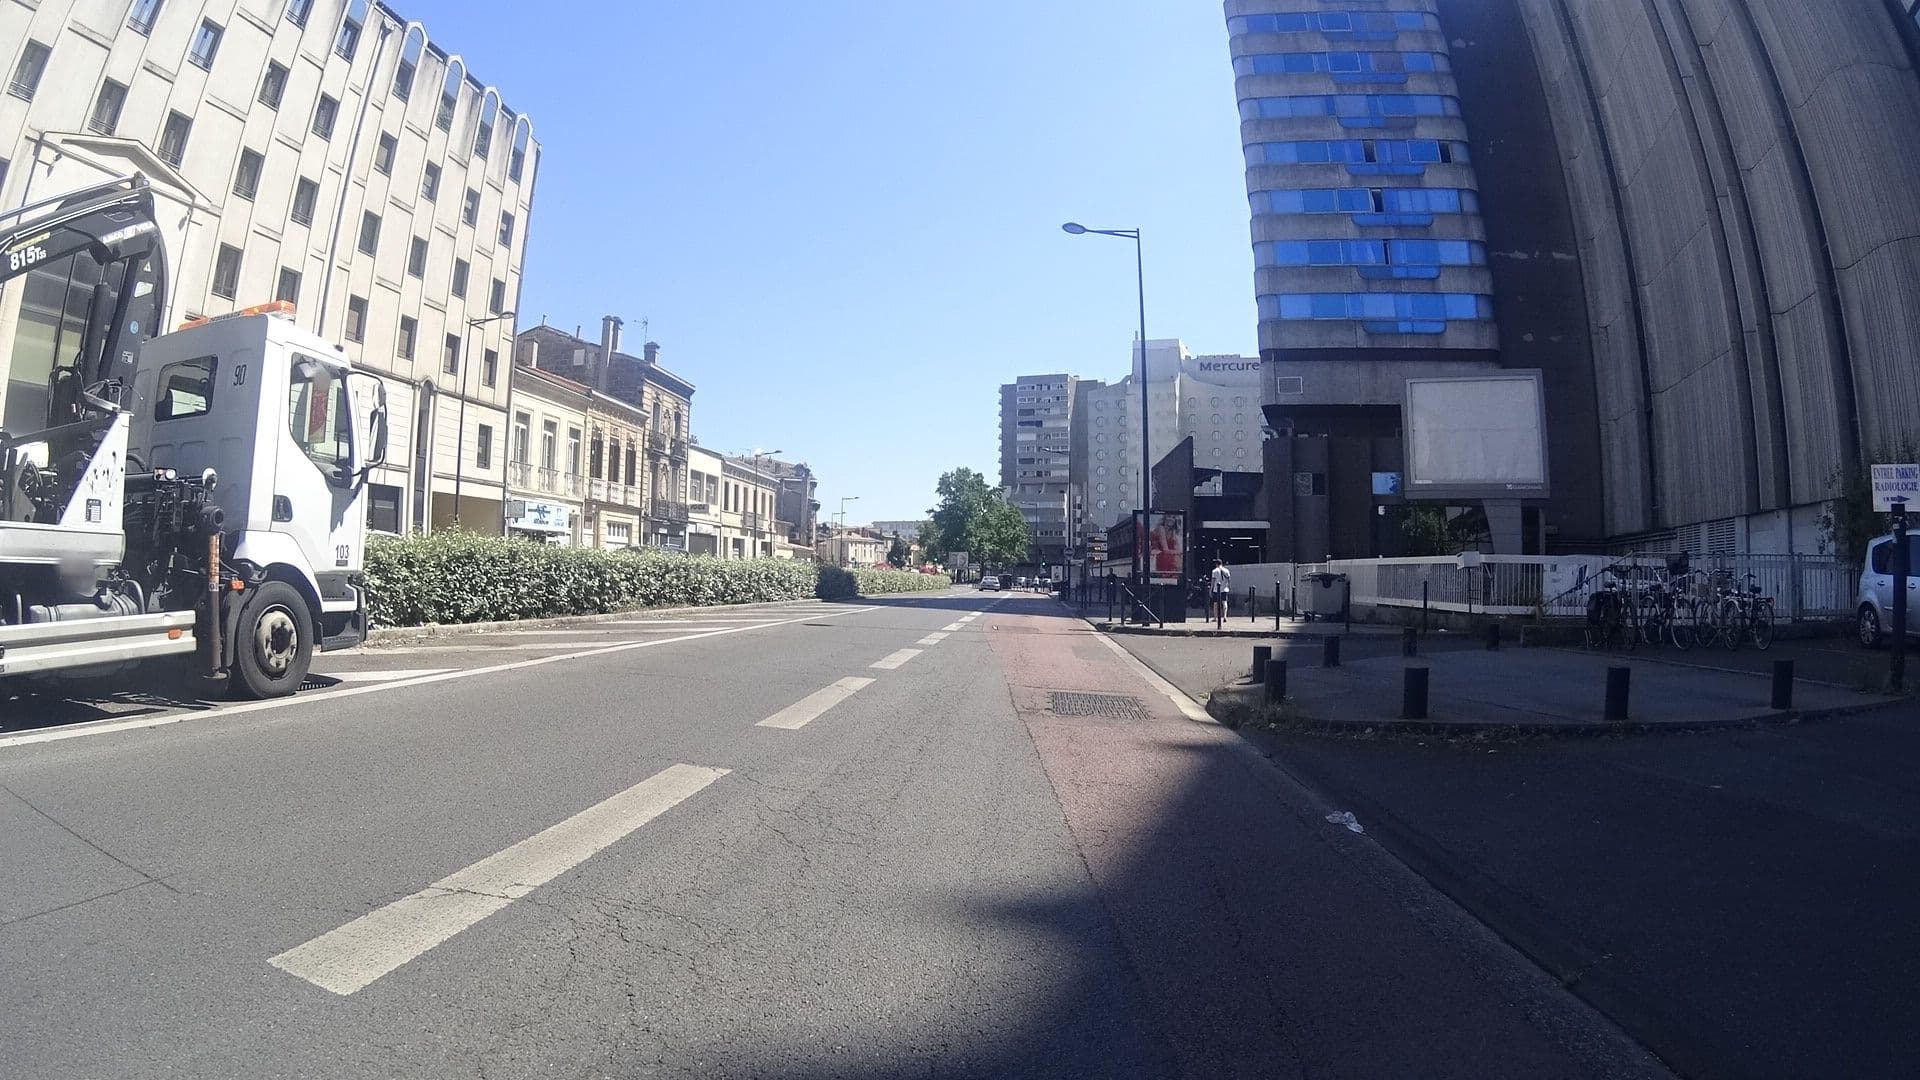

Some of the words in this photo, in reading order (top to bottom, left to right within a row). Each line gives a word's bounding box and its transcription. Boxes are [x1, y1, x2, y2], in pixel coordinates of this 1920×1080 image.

[1199, 361, 1260, 372] Mercure
[233, 364, 246, 386] 90
[1875, 482, 1918, 491] RADIOLOGIE
[336, 544, 350, 559] 103
